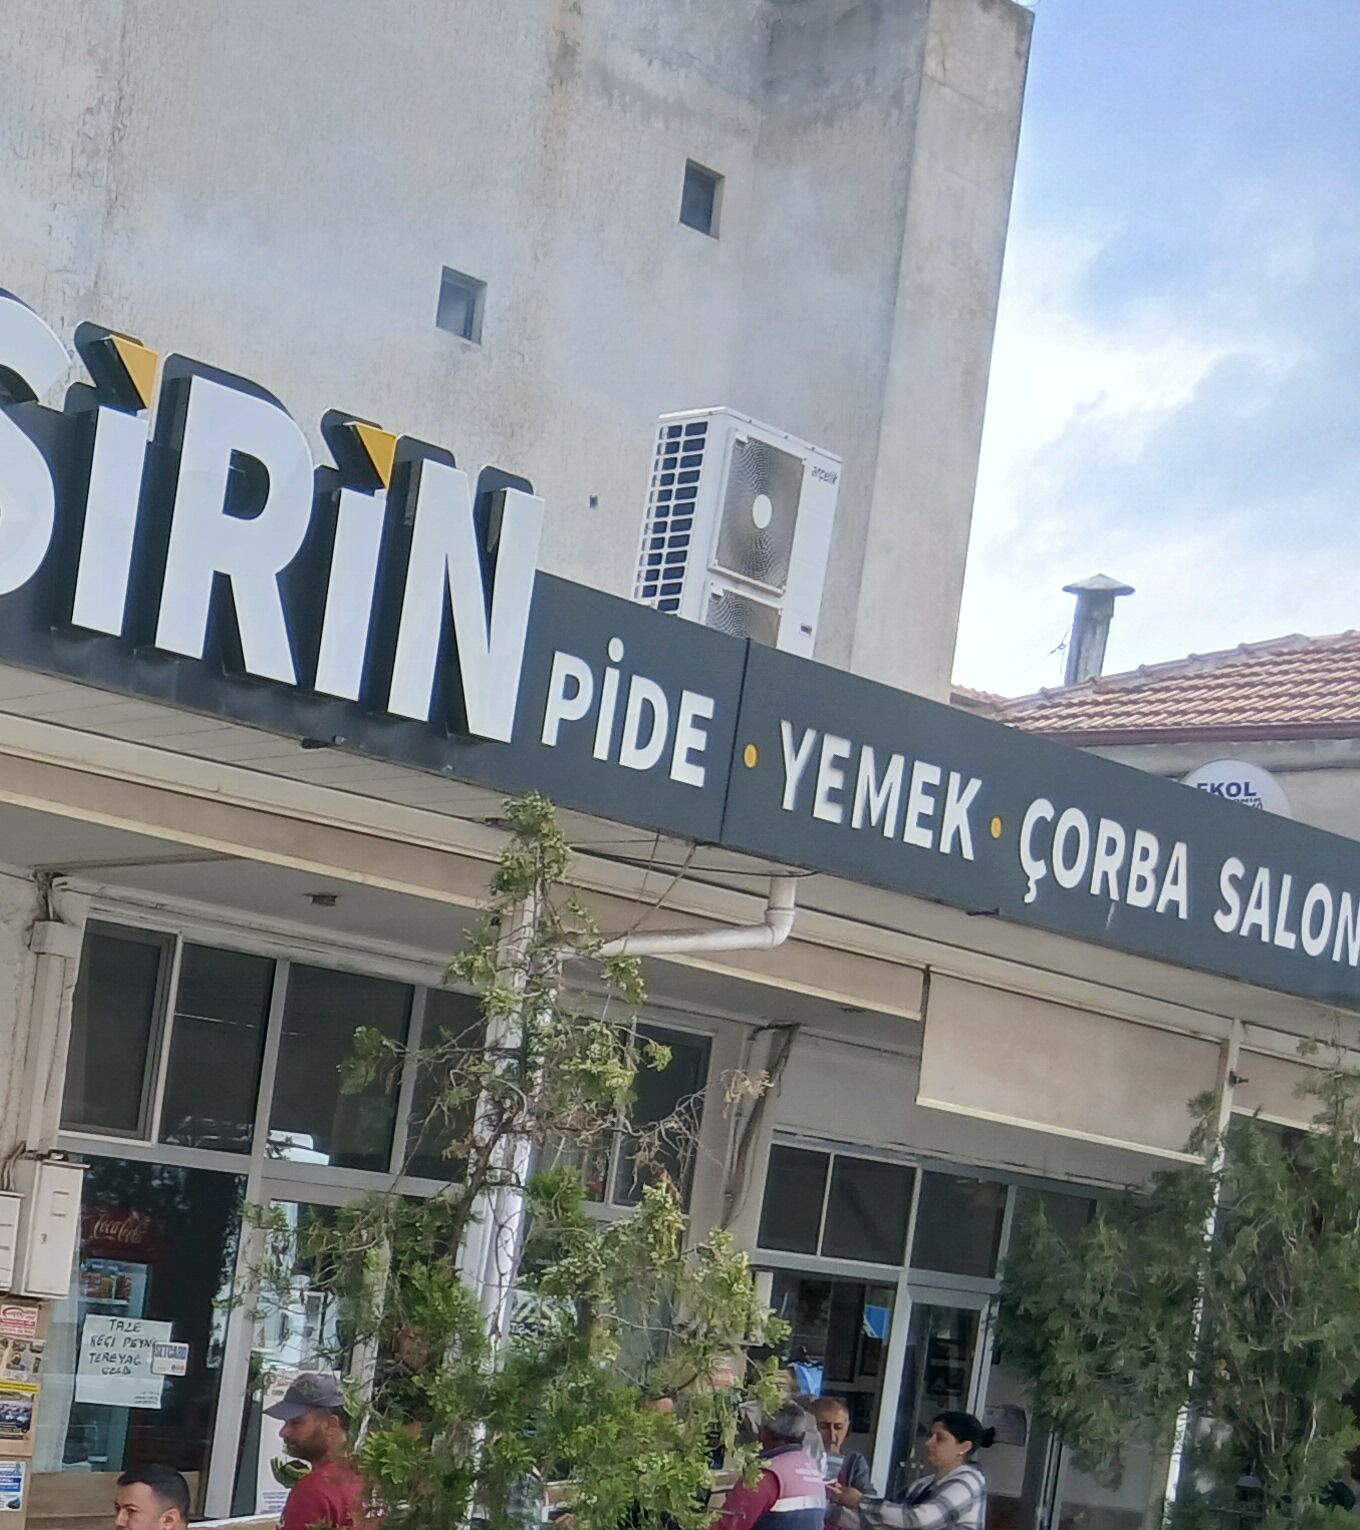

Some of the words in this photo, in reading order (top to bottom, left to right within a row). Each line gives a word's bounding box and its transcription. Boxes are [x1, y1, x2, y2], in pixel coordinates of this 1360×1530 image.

[541, 636, 715, 788] PİDE
[779, 719, 983, 862] YEMEK
[1018, 797, 1191, 905] ÇORBA
